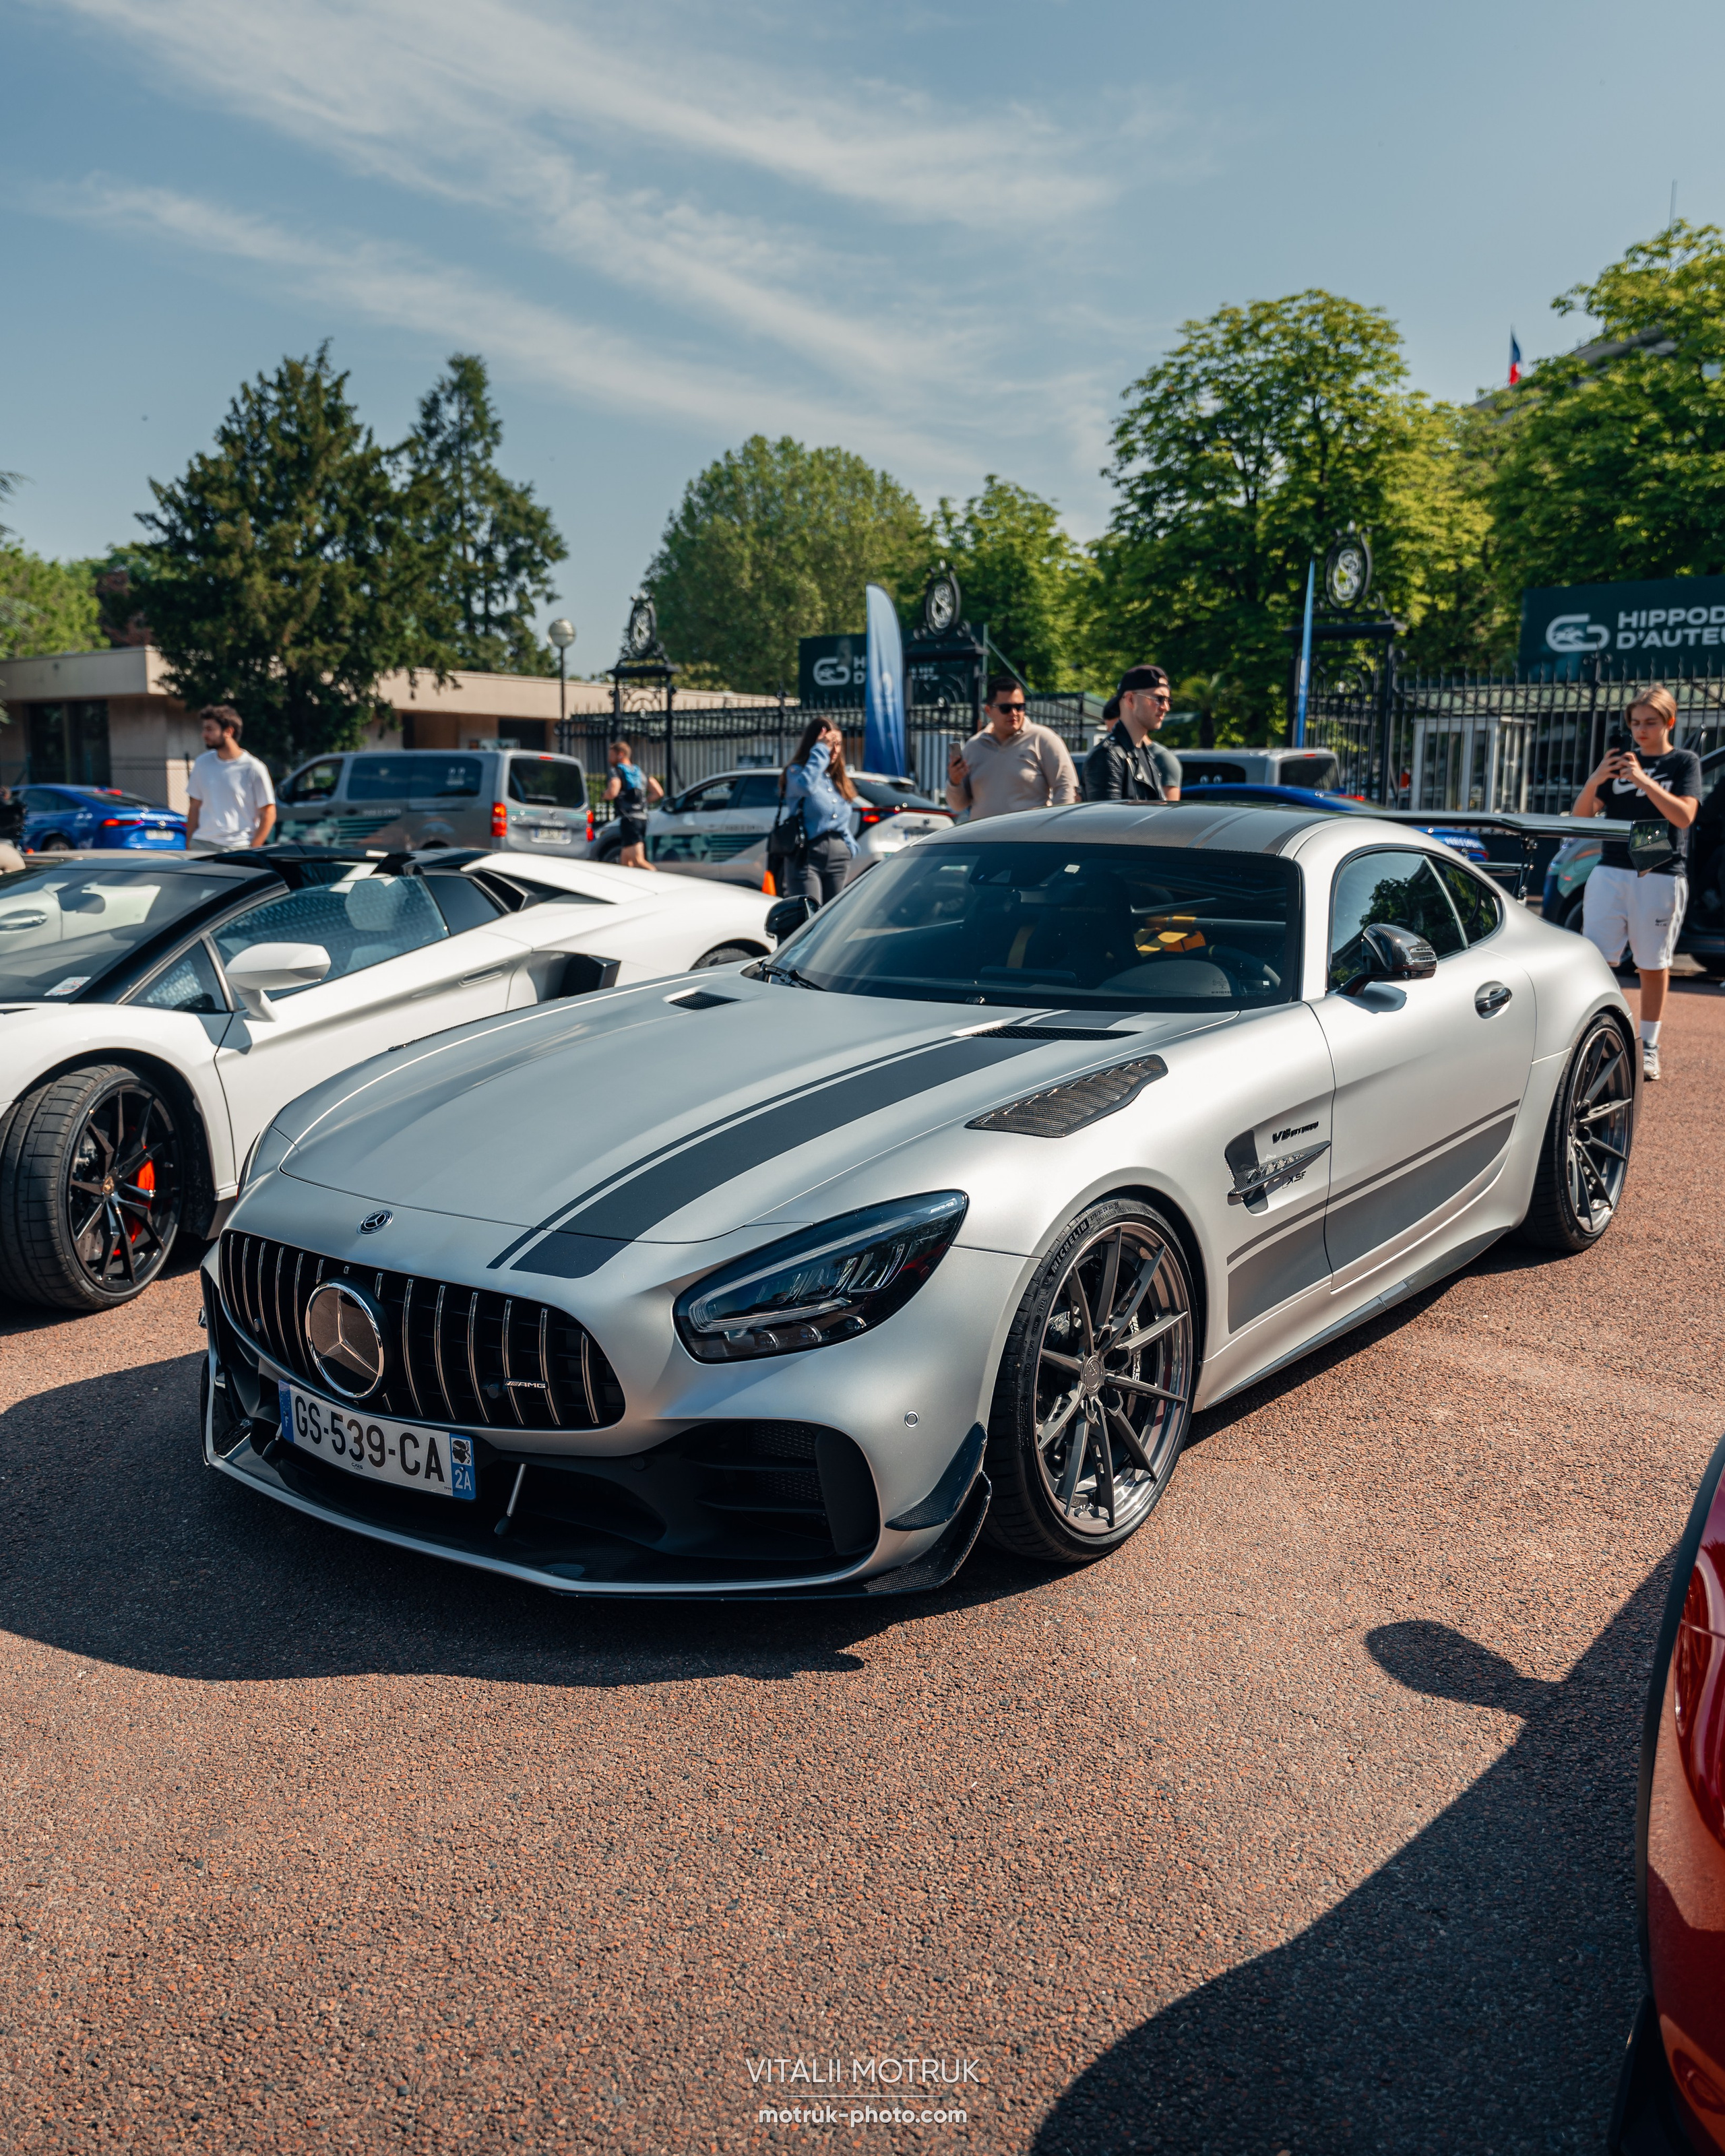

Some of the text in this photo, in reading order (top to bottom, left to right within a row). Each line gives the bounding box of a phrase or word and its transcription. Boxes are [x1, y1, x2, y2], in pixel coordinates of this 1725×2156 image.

[1617, 627, 1725, 649] D'AUTE
[1050, 1221, 1088, 1274] MICHELIN
[294, 1395, 445, 1483] GS-539-CA
[454, 1469, 472, 1491] 2A
